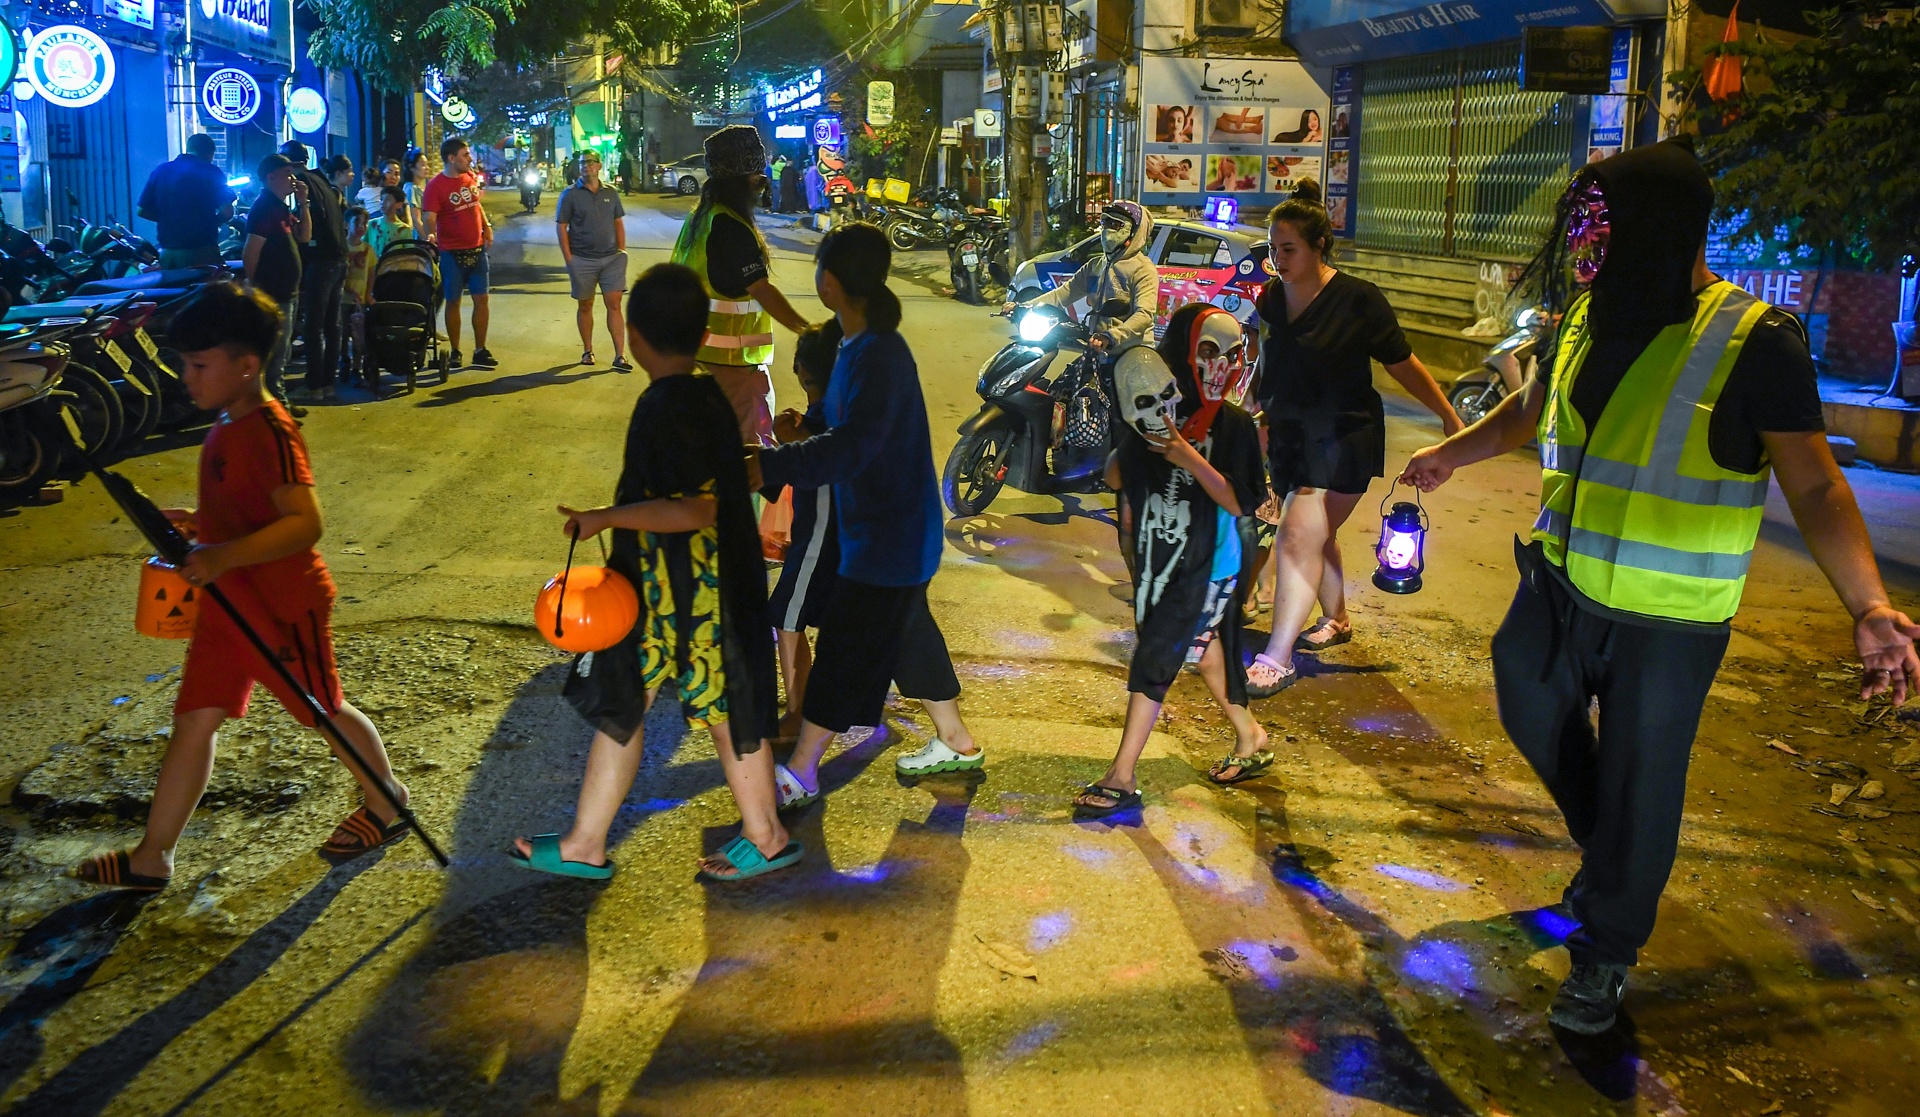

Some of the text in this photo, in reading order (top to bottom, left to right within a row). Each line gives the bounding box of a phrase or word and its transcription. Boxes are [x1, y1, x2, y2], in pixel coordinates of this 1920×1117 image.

[1360, 2, 1481, 38] BEAUTY & HAIR
[35, 33, 101, 60] PAULANER
[208, 72, 254, 92] PASTEUR STREET
[1200, 62, 1265, 97] Lancy Spa
[241, 106, 251, 116] CO
[1334, 141, 1347, 149] BODY
[1762, 269, 1803, 306] HÈ
